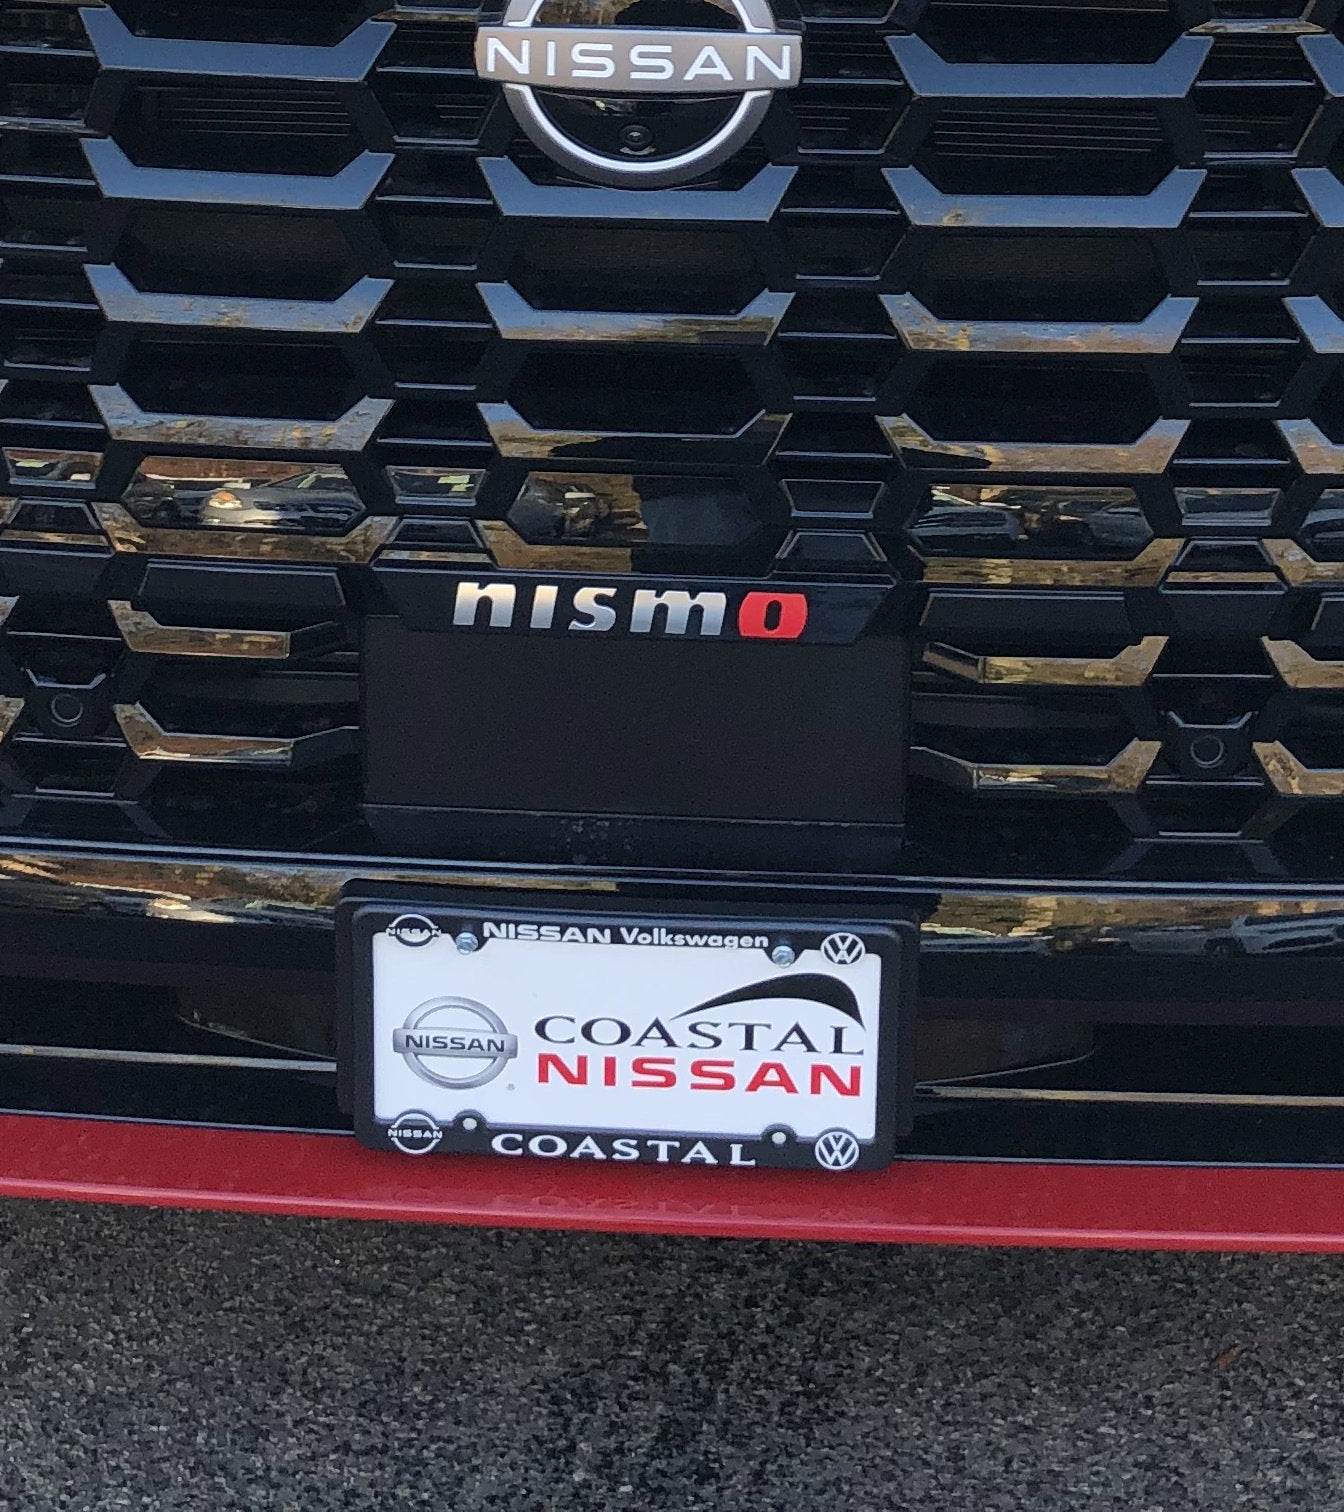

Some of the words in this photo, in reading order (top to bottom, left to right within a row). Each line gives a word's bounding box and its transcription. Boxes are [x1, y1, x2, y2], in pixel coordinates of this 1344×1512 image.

[486, 37, 791, 81] NISSAN
[453, 581, 808, 638] nismo
[386, 928, 441, 937] NISSAN
[483, 922, 611, 944] NISSAN
[620, 927, 769, 948] Volkswagen
[405, 1034, 505, 1052] NISSAN
[534, 1016, 864, 1055] COASTAL
[538, 1052, 862, 1097] NISSAN
[388, 1128, 442, 1139] NISSAN
[491, 1133, 756, 1166] COASTAL
